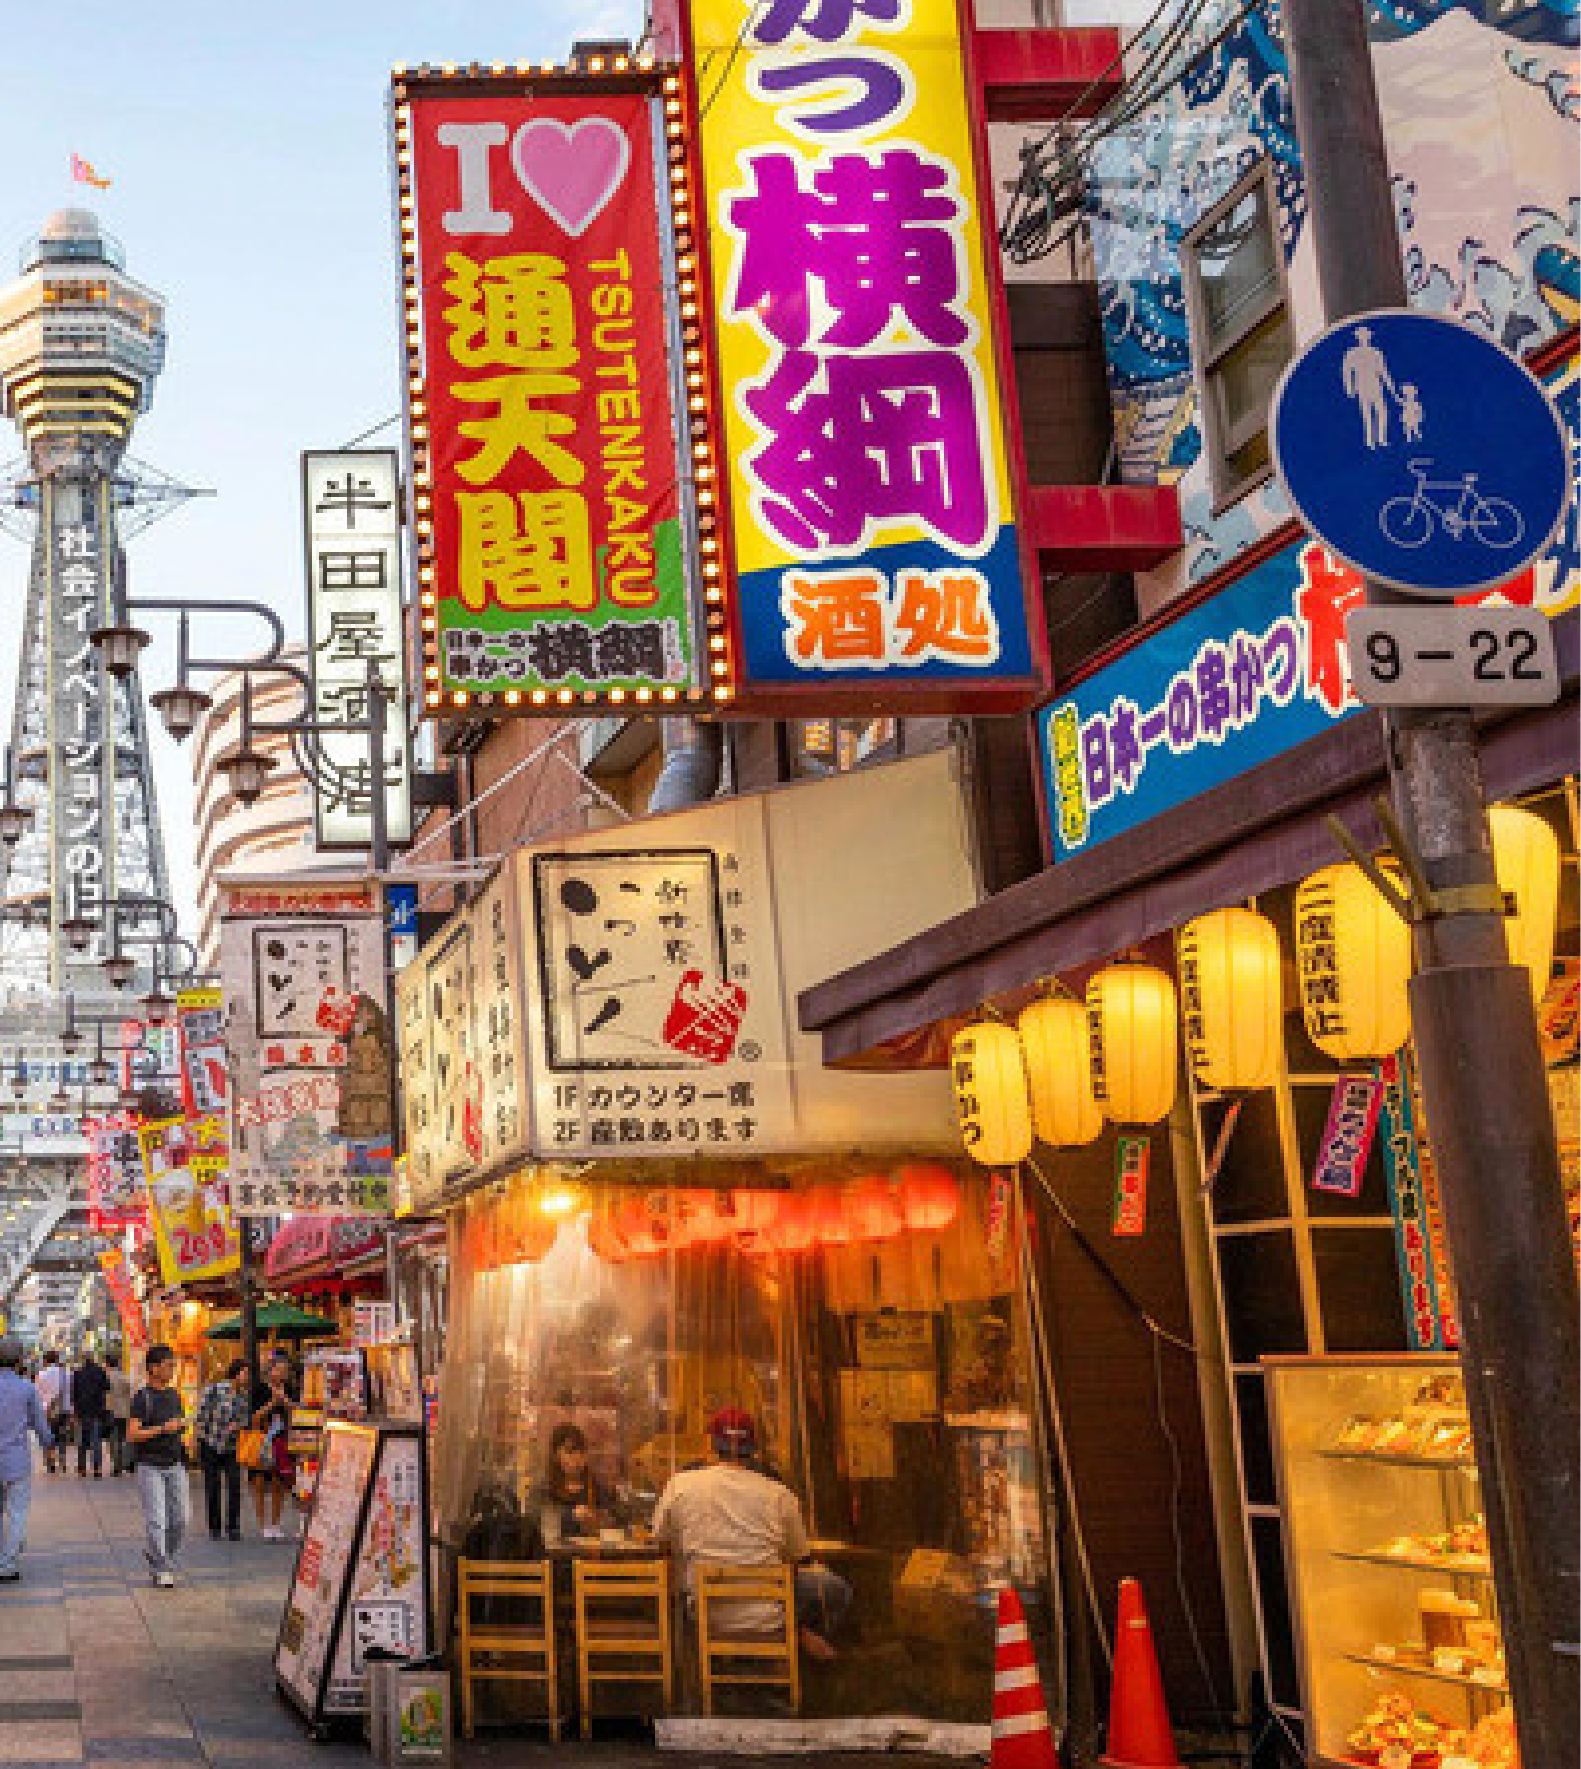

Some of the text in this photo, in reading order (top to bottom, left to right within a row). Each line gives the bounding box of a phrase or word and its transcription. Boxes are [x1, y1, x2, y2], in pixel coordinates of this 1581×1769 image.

[437, 122, 513, 236] I
[730, 148, 989, 549] 横綱
[441, 250, 598, 611] 通天閣
[584, 247, 660, 604] TSUTENKAKU
[528, 622, 665, 681] 横綱
[789, 578, 991, 660] 酒処
[1080, 624, 1298, 805] 日本一の串かつ
[554, 1117, 758, 1143] 2F 座敷あります
[555, 1083, 756, 1110] 1F カウンター席
